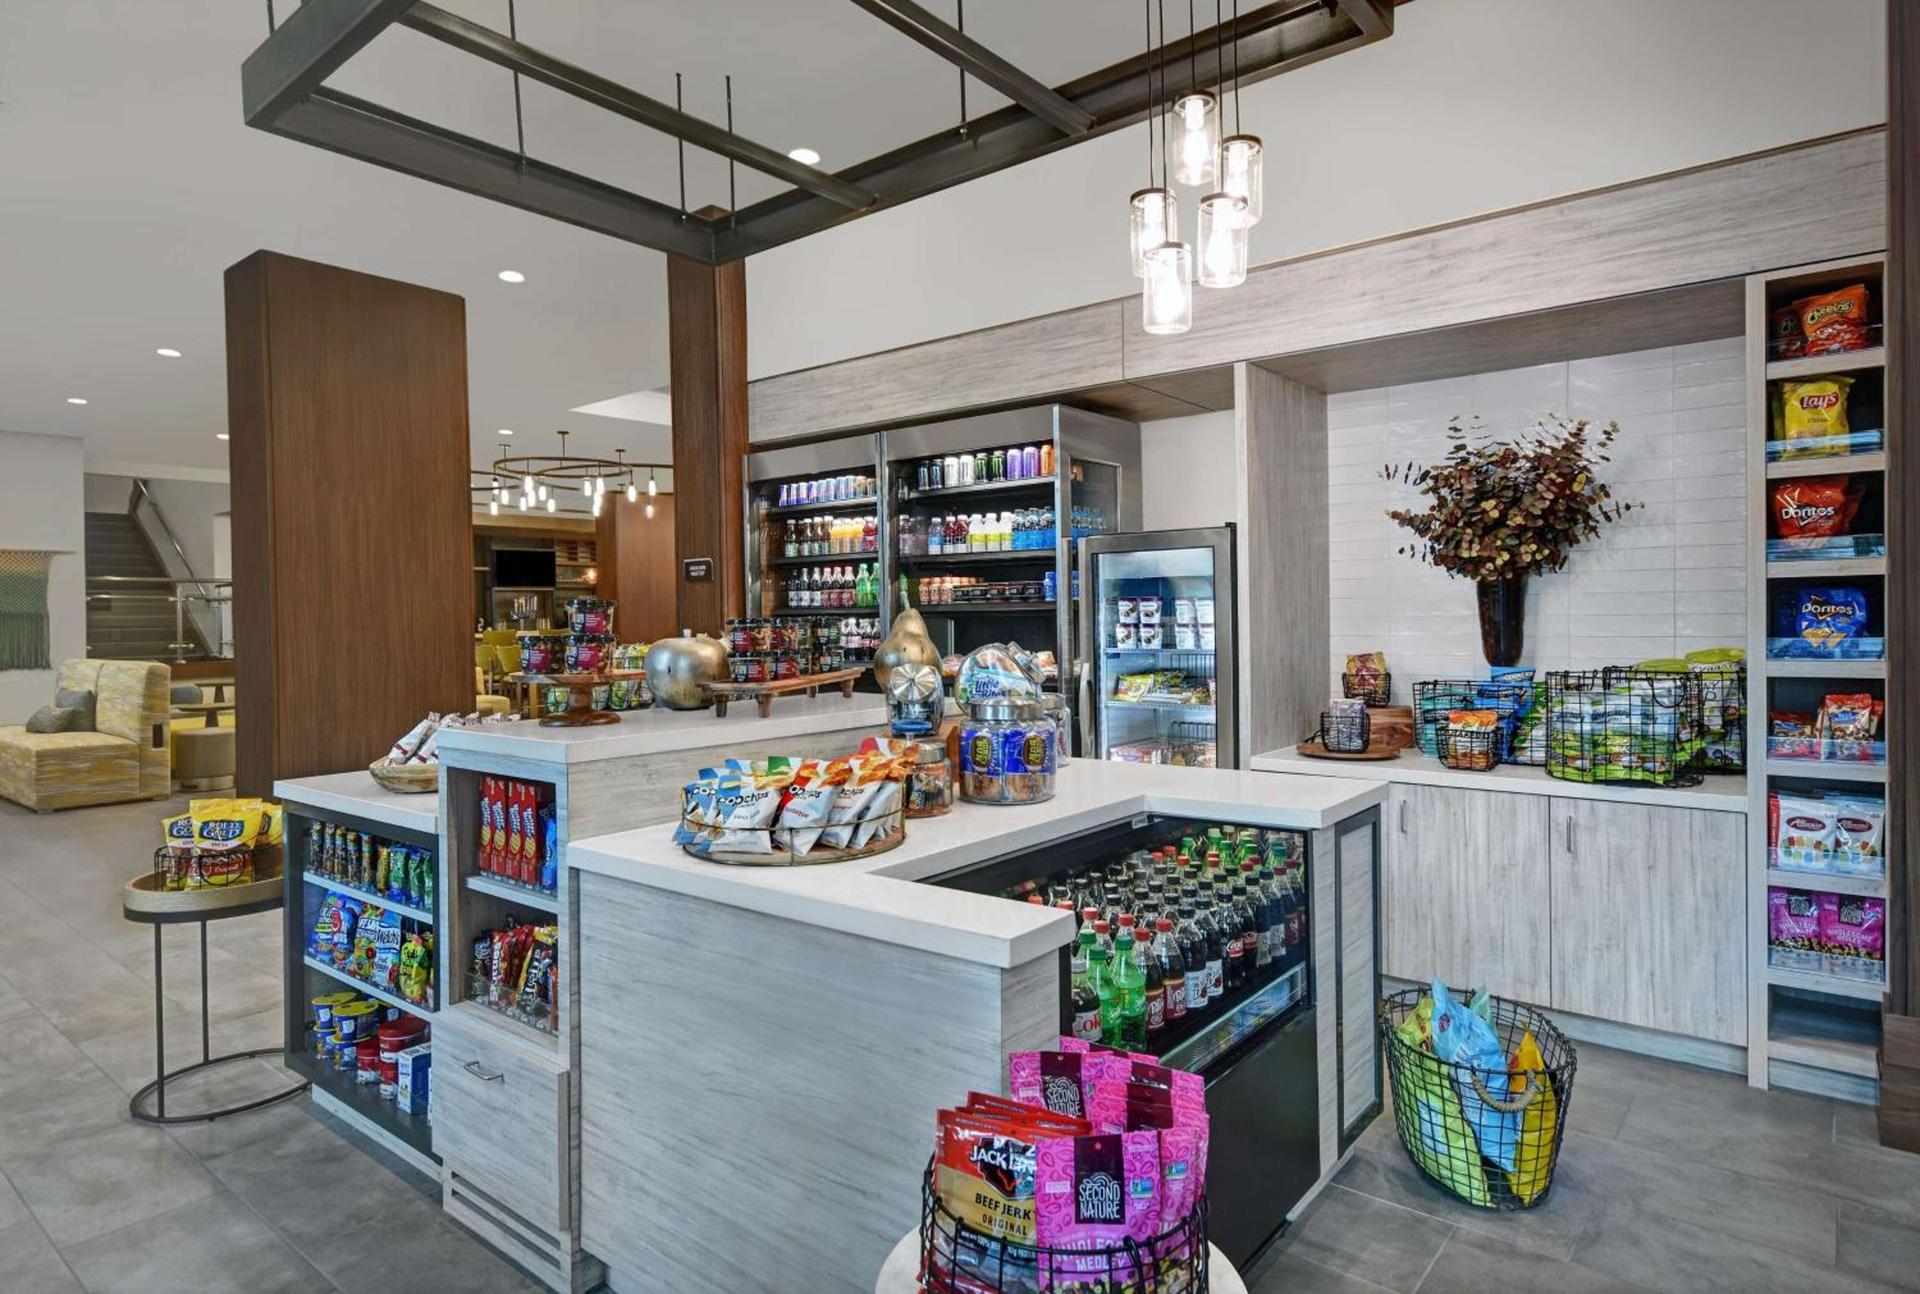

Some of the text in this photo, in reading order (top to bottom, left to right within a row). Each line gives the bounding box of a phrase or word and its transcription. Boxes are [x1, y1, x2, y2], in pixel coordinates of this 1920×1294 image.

[1782, 505, 1835, 520] Doritos
[1802, 603, 1854, 615] Doritos
[203, 828, 240, 839] GOLD
[970, 1145, 1008, 1170] JACK
[1079, 1180, 1121, 1201] SECOND
[975, 1192, 1036, 1220] BEEF JERK
[1079, 1201, 1121, 1220] NATURE
[982, 1213, 1028, 1236] ORIGINAL
